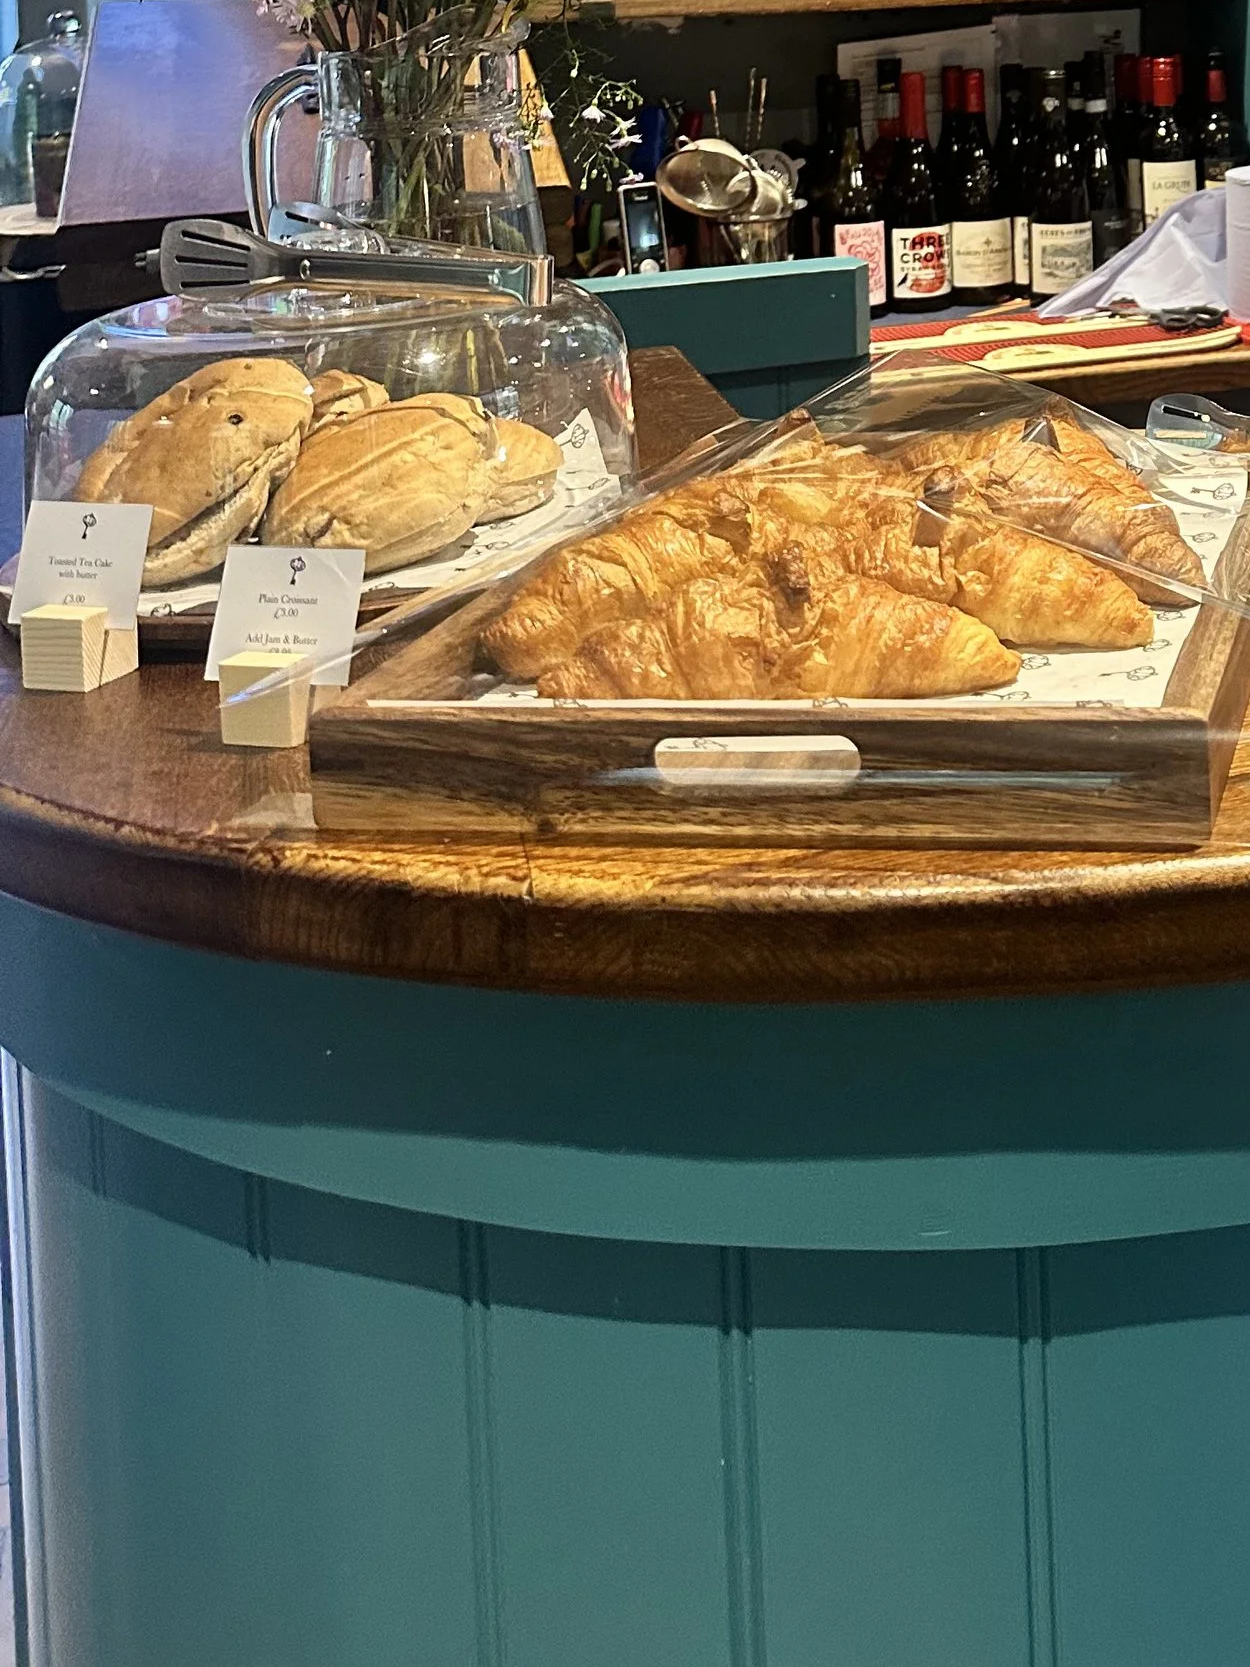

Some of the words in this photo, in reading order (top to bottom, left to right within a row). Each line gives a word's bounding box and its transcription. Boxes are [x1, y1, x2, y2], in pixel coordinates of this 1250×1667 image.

[48, 555, 77, 566] Toasted
[78, 557, 93, 567] Tea
[94, 558, 113, 568] Cake
[58, 569, 75, 579] with
[76, 569, 98, 580] butter
[258, 593, 279, 604] Plain
[280, 593, 319, 605] Croissant
[245, 633, 263, 644] Add
[262, 633, 281, 646] Jam
[282, 635, 291, 645] &
[293, 634, 318, 646] Butter
